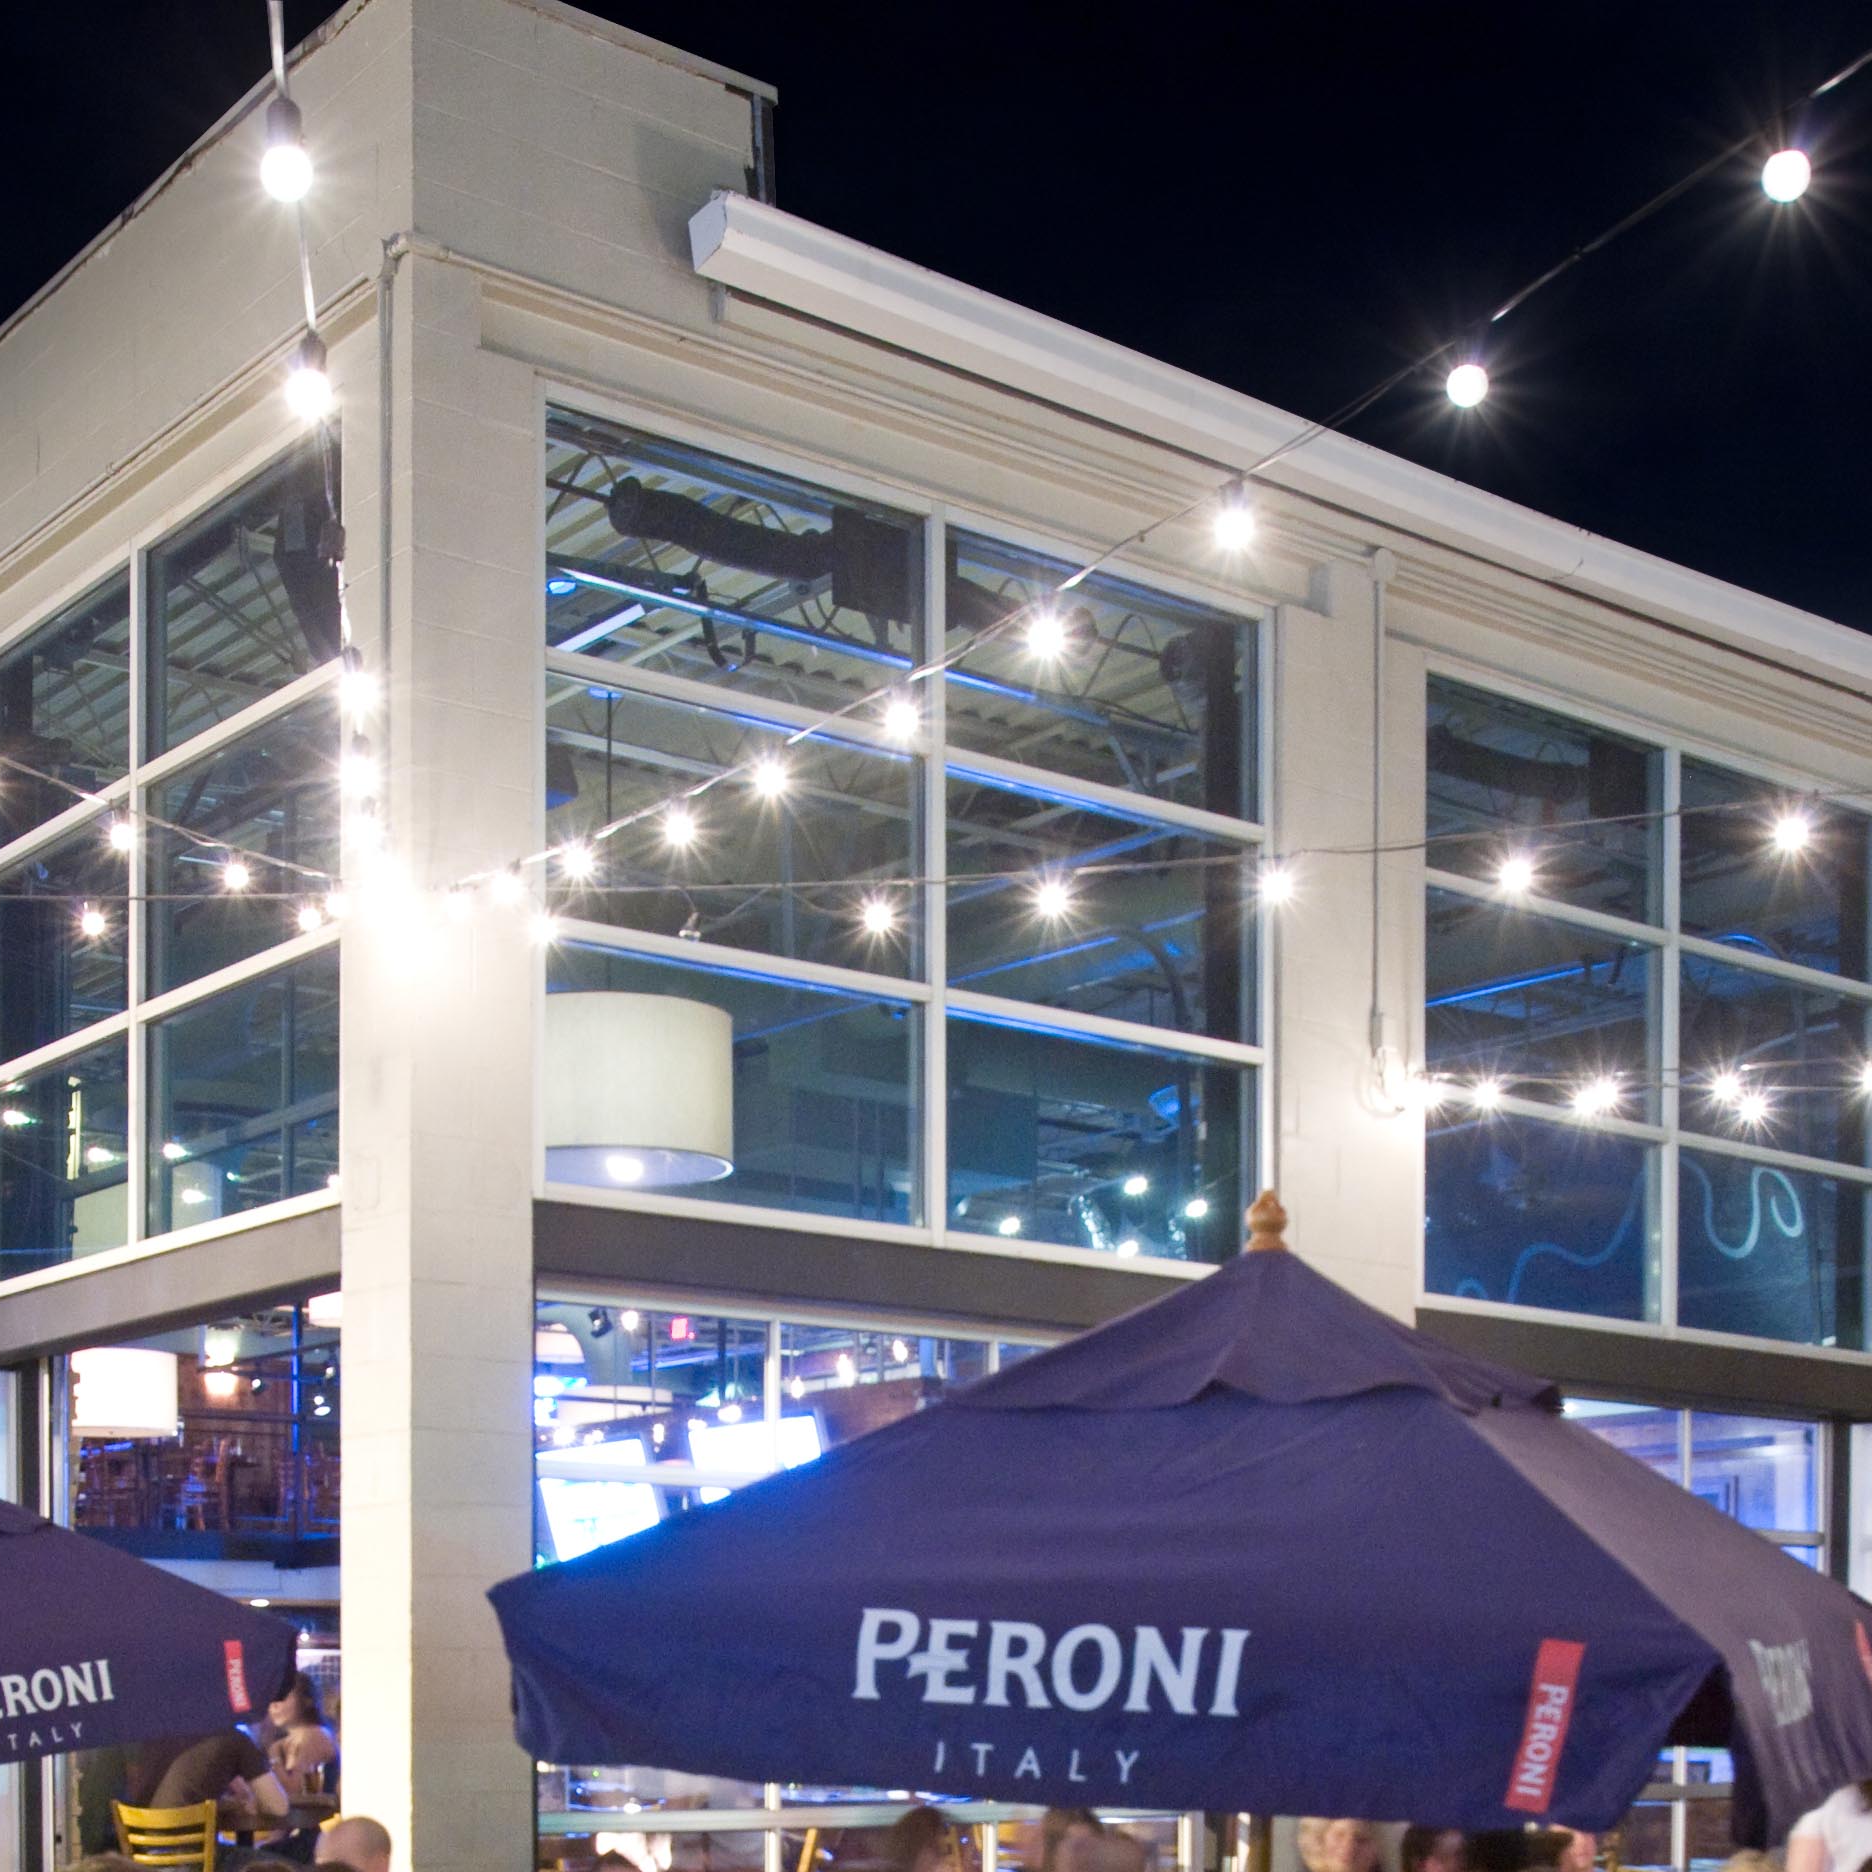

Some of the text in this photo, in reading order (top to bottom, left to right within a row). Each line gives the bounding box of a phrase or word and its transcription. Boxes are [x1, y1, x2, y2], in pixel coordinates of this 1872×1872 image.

[851, 1607, 1252, 1718] PERONI
[934, 1741, 1141, 1785] ITALY
[1515, 1682, 1570, 1797] PERONI
